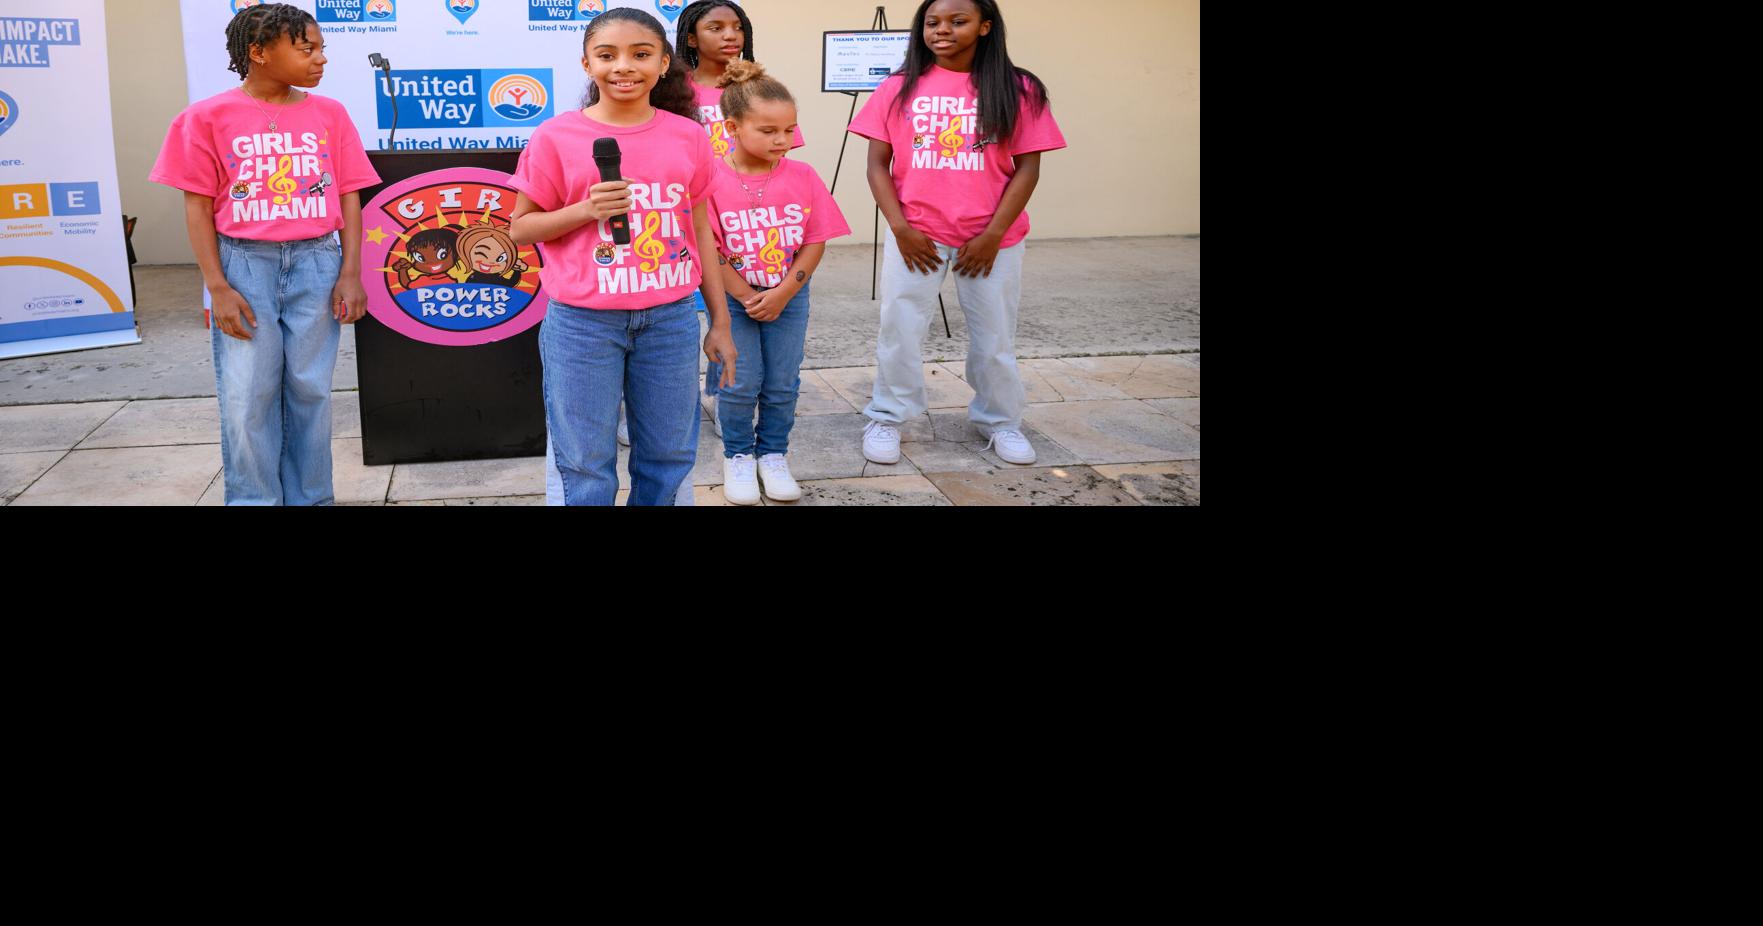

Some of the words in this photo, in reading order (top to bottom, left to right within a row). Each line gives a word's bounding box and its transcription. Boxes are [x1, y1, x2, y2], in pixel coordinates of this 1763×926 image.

[318, 0, 361, 8] United
[335, 9, 361, 20] Way
[548, 8, 573, 19] Way
[0, 44, 47, 64] AKE.
[380, 75, 476, 96] United
[419, 99, 476, 125] Way
[231, 132, 319, 158] GIRLS
[379, 136, 442, 150] United
[448, 136, 489, 150] Way
[496, 136, 530, 150] Mia
[238, 154, 321, 181] CHIR
[911, 150, 985, 171] MIAMI
[13, 192, 34, 211] R
[67, 190, 86, 208] E
[397, 186, 503, 219] GIR
[627, 183, 685, 210] RLS
[232, 196, 327, 223] MIAMI
[719, 203, 804, 233] GIRLS
[60, 221, 99, 229] Economic
[64, 228, 96, 236] Mobility
[725, 225, 804, 253] CHIR
[597, 260, 693, 294] MIAMI
[416, 287, 511, 303] POWER
[422, 302, 507, 319] ROCKS
